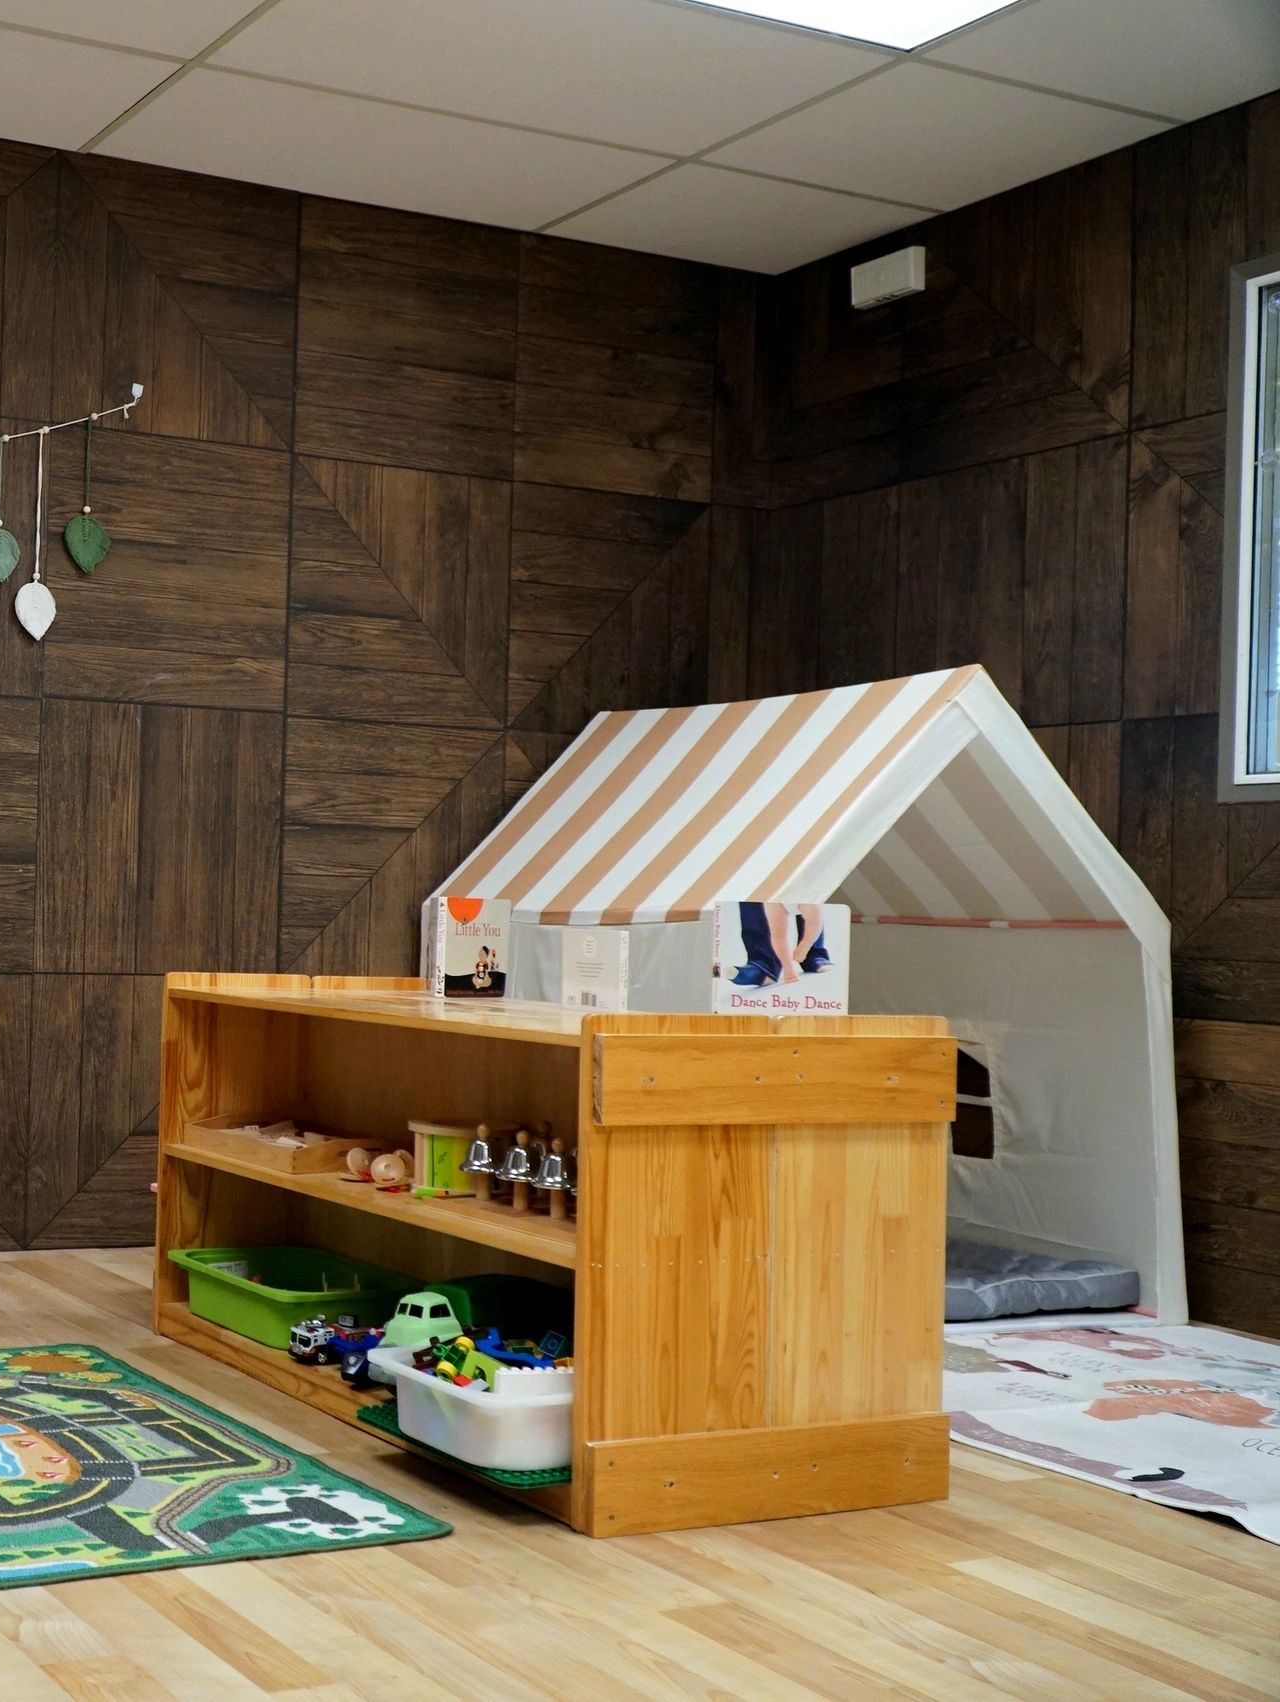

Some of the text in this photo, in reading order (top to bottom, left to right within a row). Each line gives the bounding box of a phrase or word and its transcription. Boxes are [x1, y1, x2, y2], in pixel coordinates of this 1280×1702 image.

[455, 922, 501, 937] Little You
[731, 994, 842, 1012] Dance Baby Dance
